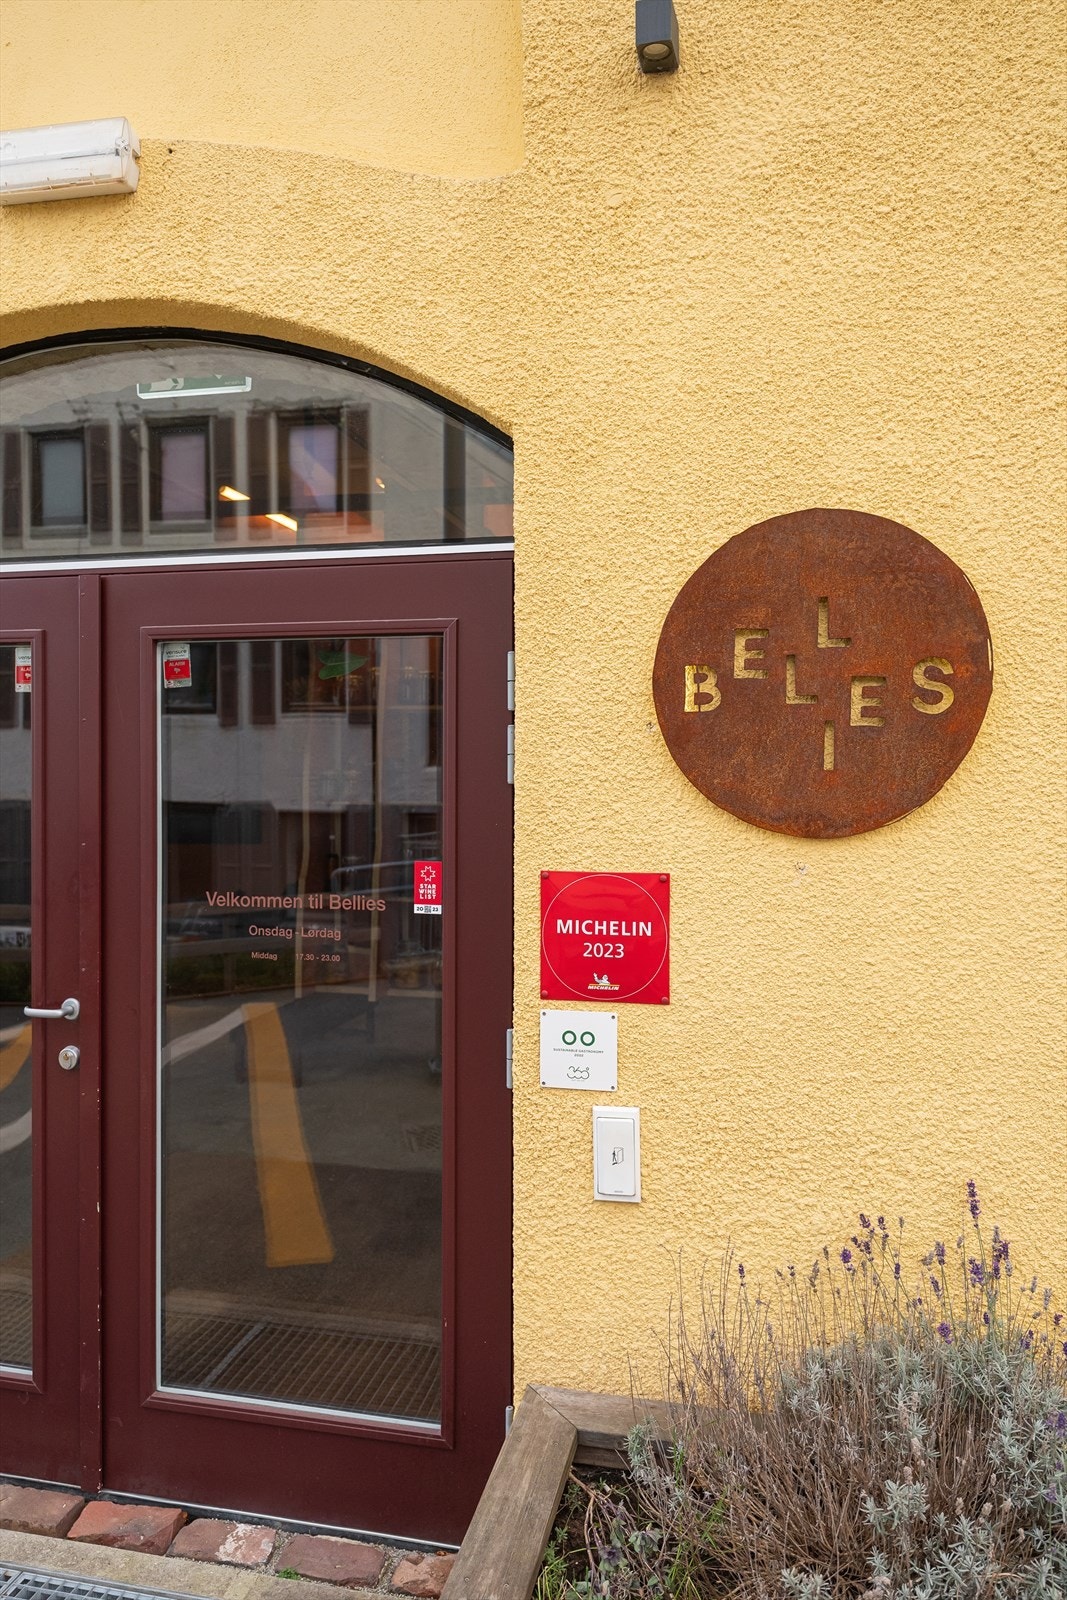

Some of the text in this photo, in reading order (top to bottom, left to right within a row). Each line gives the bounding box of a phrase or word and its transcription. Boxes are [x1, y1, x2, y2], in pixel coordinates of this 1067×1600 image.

[205, 890, 387, 911] Velkommen til Bellies
[248, 925, 293, 940] Onsdag
[301, 926, 341, 941] Lørdag
[556, 919, 653, 937] MICHELIN
[251, 951, 278, 961] Middag
[295, 953, 315, 961] 17.30
[321, 954, 341, 962] 23.00
[582, 942, 625, 959] 2023
